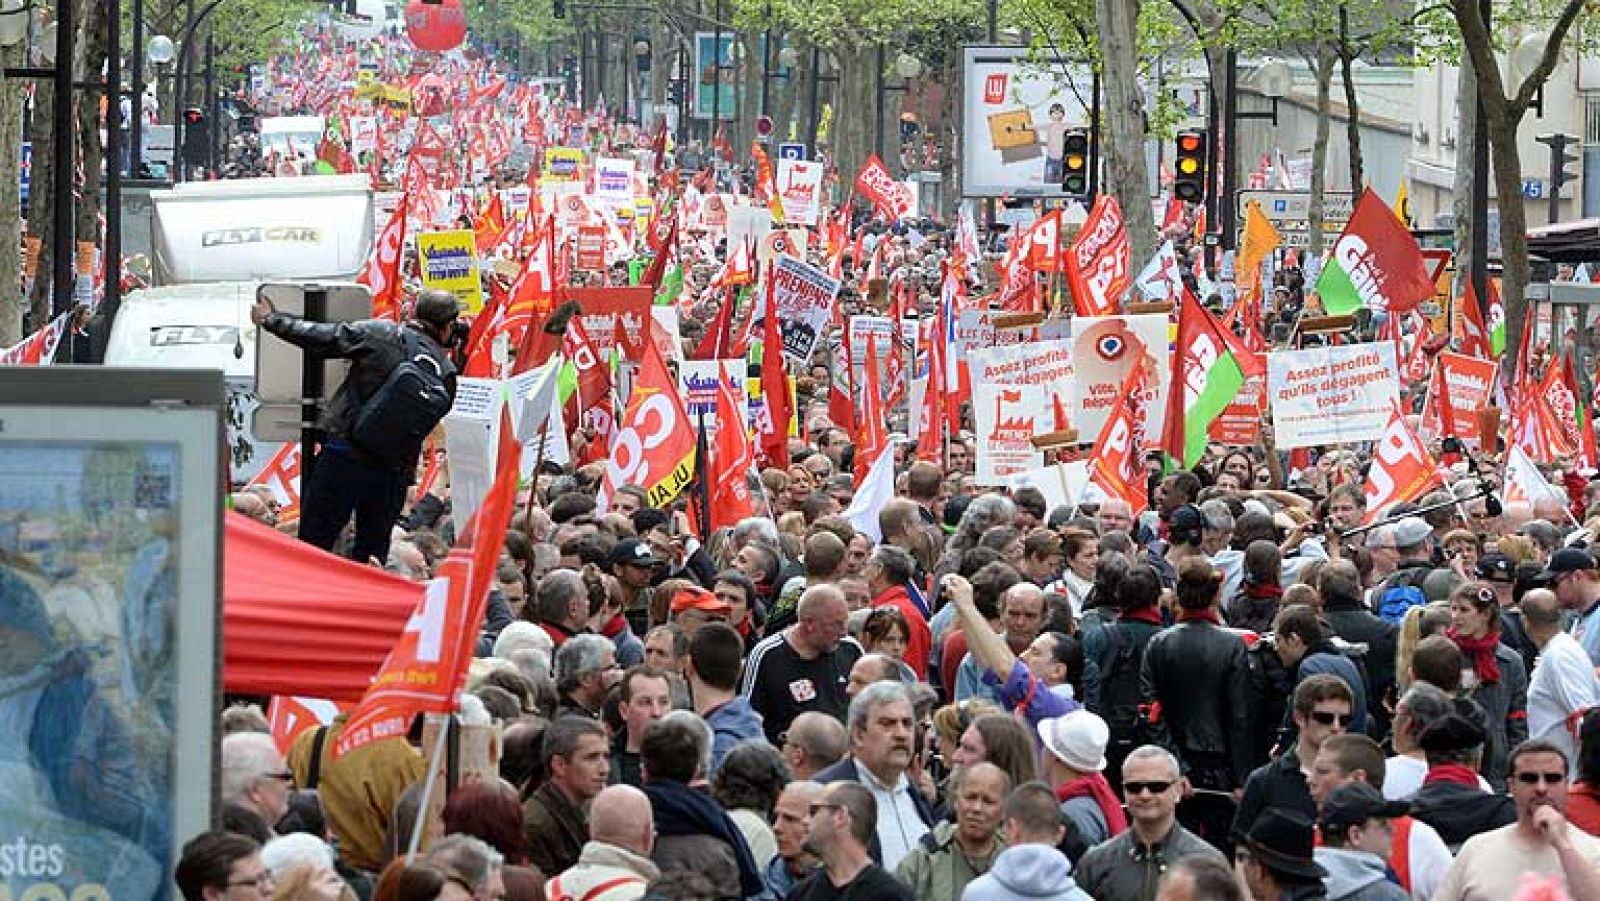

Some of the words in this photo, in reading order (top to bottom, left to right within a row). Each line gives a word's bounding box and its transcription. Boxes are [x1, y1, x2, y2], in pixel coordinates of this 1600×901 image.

[264, 227, 321, 243] CAR
[984, 357, 1021, 379] Assez
[1286, 364, 1328, 382] Assez
[1331, 351, 1380, 374] profité
[1279, 382, 1317, 400] qu'ils
[1321, 368, 1390, 391] dégagent
[1316, 393, 1349, 408] tous
